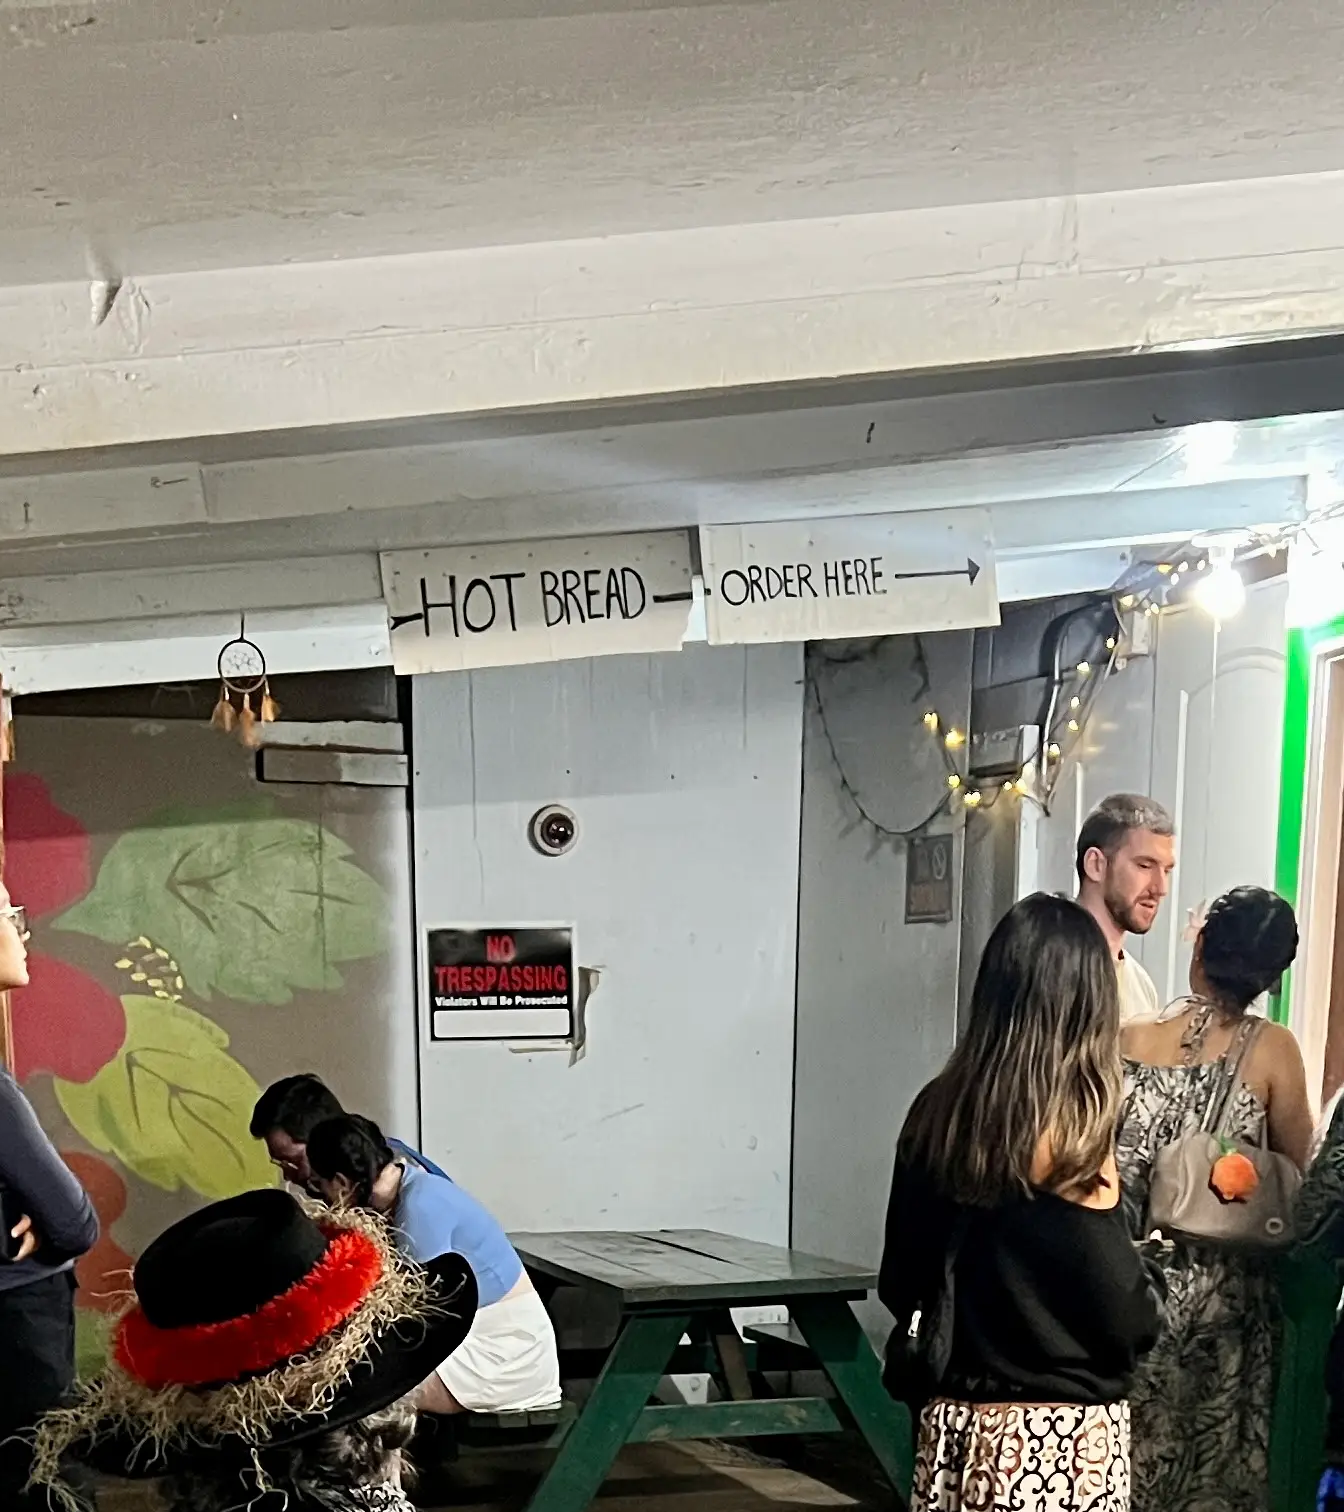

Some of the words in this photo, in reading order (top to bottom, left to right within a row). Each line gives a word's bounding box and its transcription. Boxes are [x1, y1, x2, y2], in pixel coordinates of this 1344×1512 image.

[720, 563, 819, 606] ORDER
[823, 556, 886, 597] HERE
[420, 572, 524, 637] HOT
[541, 567, 645, 626] BREAD
[486, 935, 516, 962] NO
[435, 965, 567, 992] TRESPASSING
[435, 996, 478, 1006] Violators
[480, 996, 498, 1006] Will
[500, 995, 513, 1005] Be
[515, 995, 567, 1005] Prosecuted
